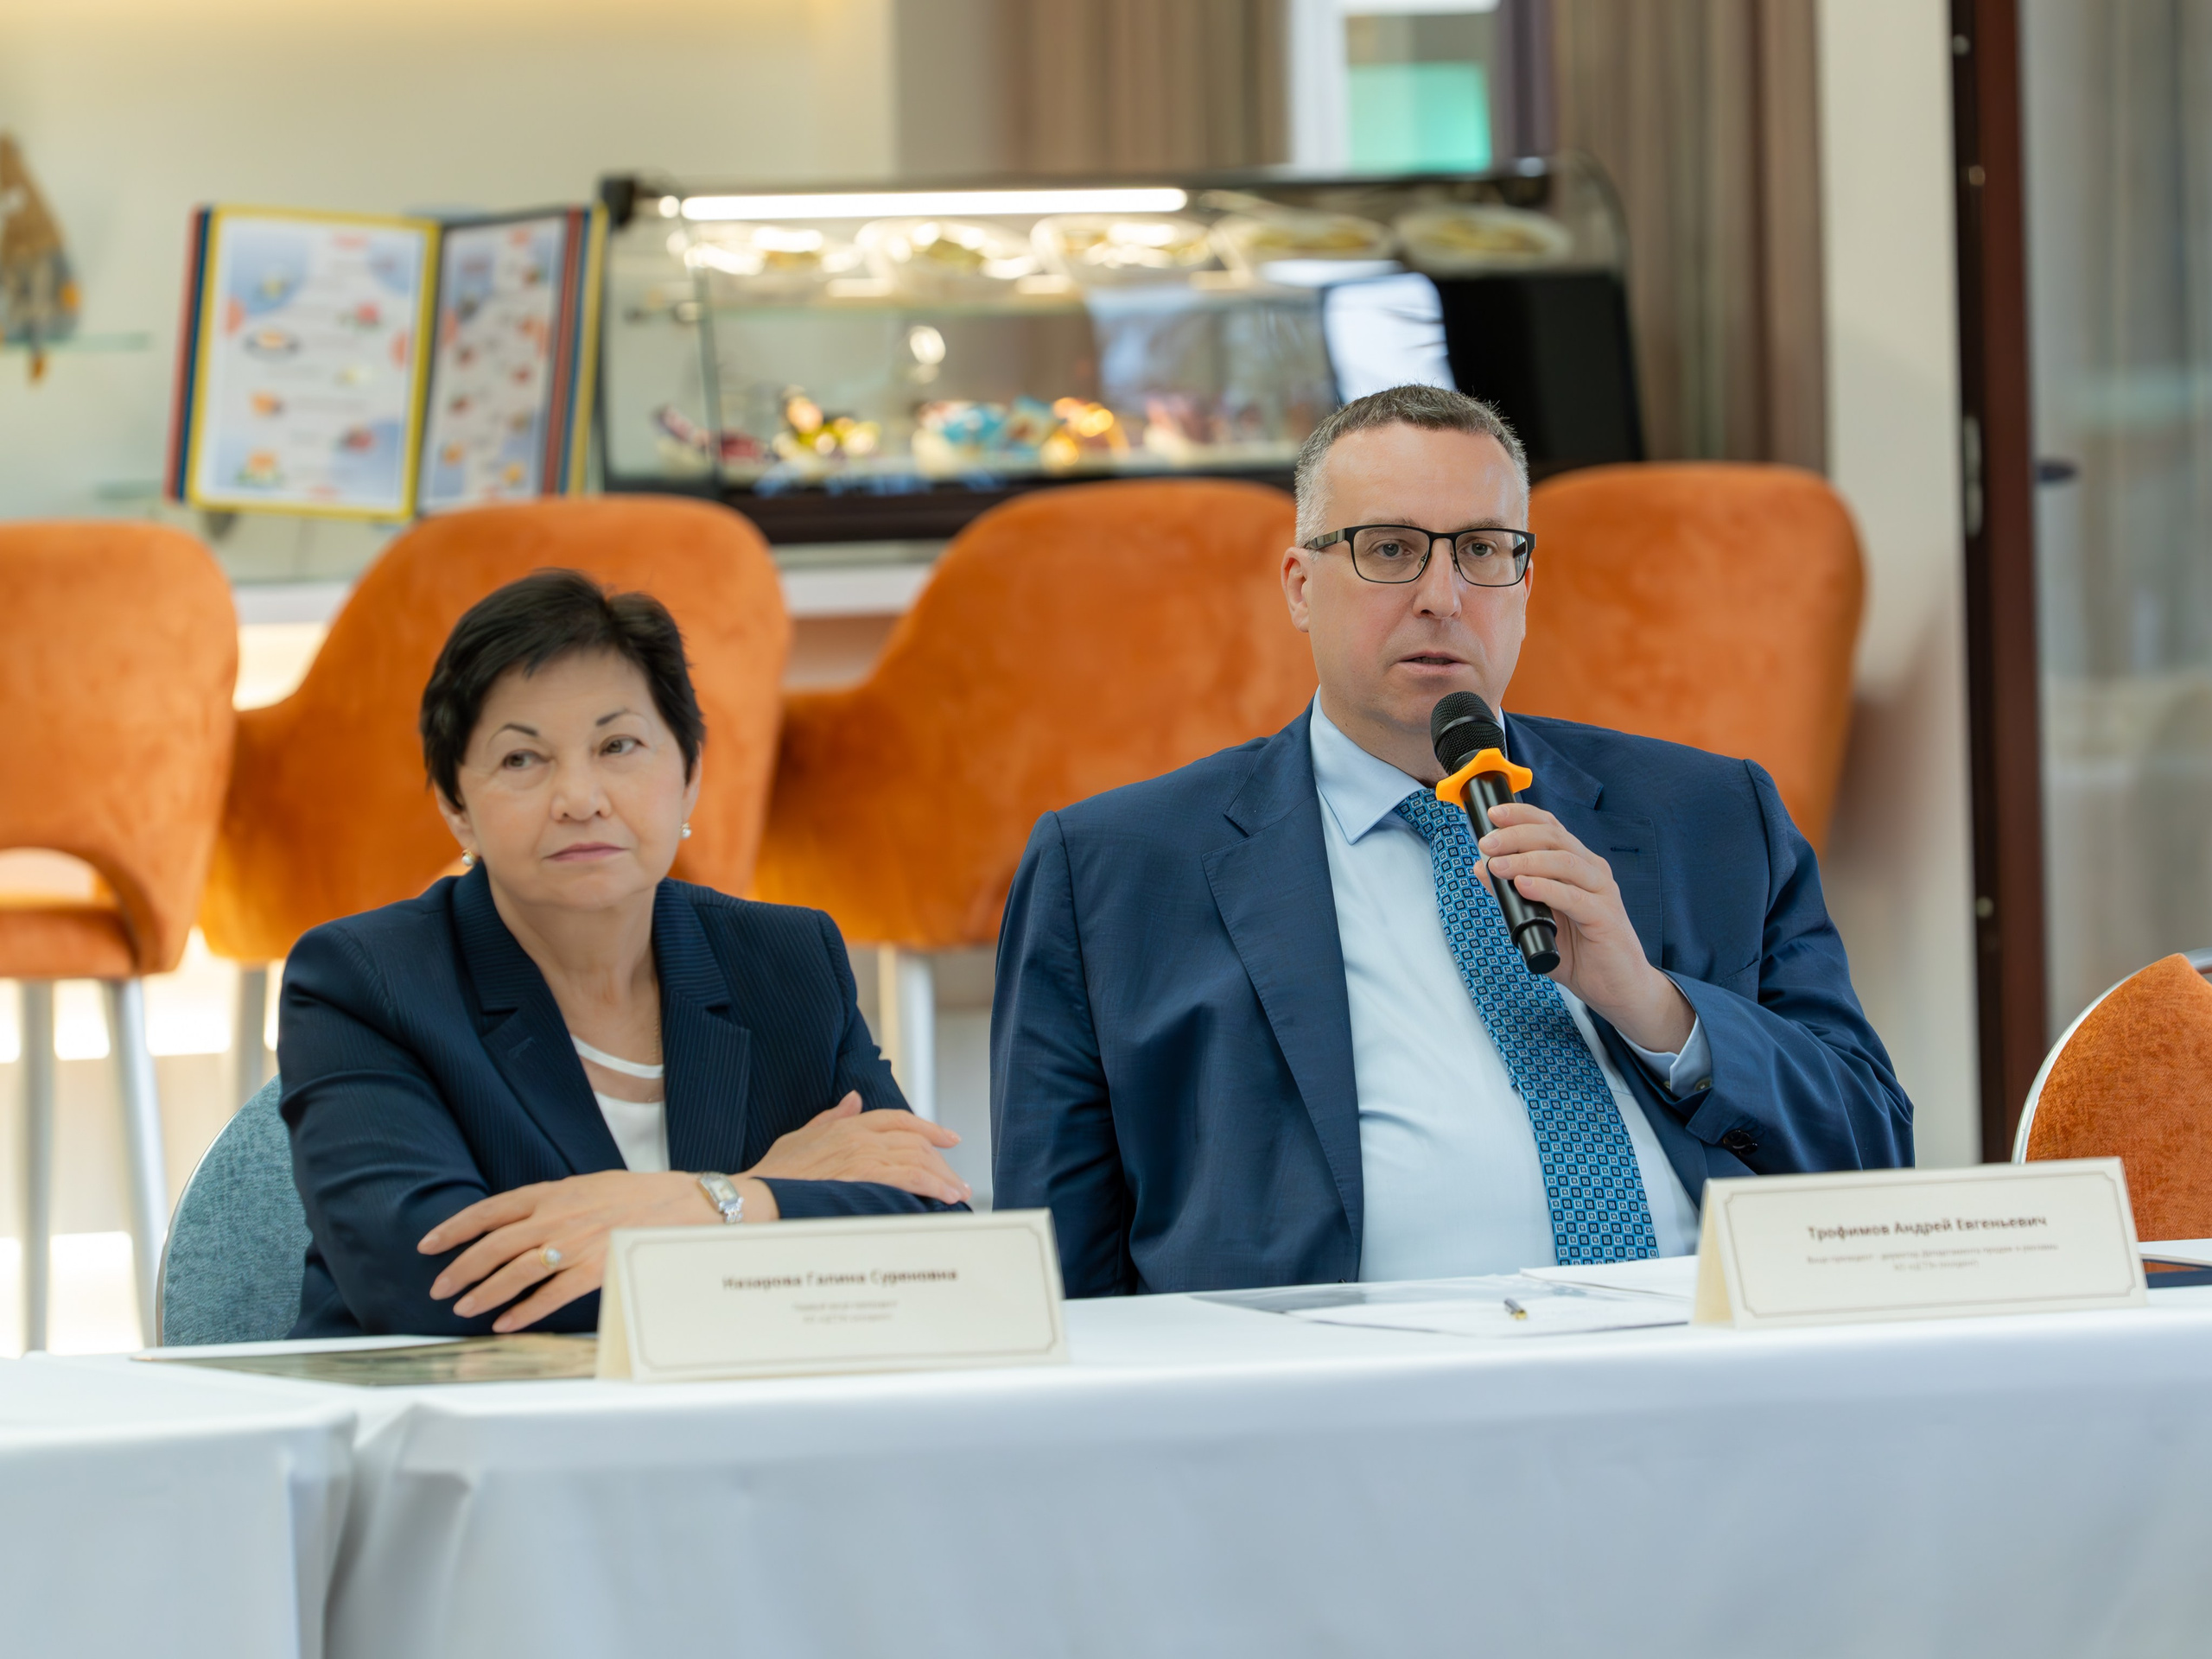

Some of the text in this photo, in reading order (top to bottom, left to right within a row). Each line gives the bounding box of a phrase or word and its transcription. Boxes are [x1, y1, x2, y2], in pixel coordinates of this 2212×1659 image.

[1807, 1216, 2048, 1242] Трофимов Андрей Евгеньевич
[722, 1274, 802, 1292] Назарова
[806, 1270, 866, 1287] Галина
